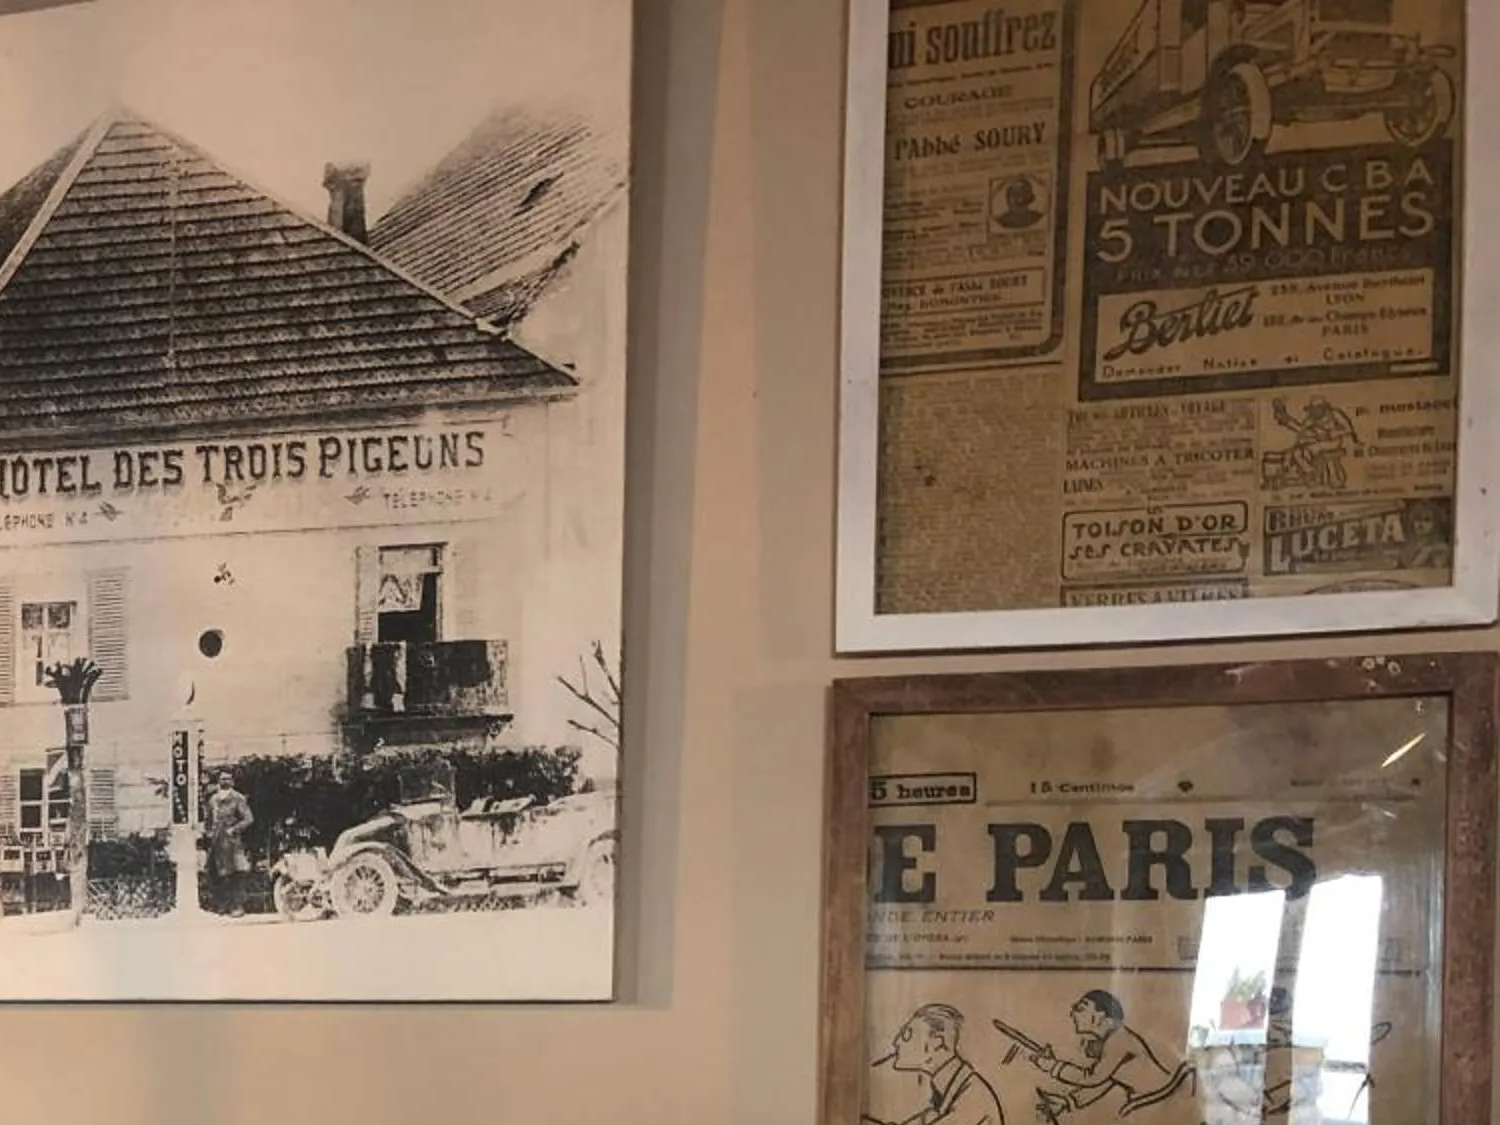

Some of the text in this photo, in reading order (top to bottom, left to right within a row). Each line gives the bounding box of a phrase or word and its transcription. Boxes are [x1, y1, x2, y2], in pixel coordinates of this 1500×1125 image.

[926, 8, 1057, 66] souffrez
[974, 121, 1047, 151] SOURY
[1100, 168, 1305, 213] NOUVEAU
[1096, 218, 1134, 263] 5
[1153, 191, 1435, 257] TONNES
[1101, 285, 1260, 362] Berliet
[113, 449, 184, 489] DES
[195, 440, 308, 483] TROIS
[1175, 513, 1237, 532] D'OR
[896, 783, 971, 800] heures
[986, 815, 1318, 902] PARIS
